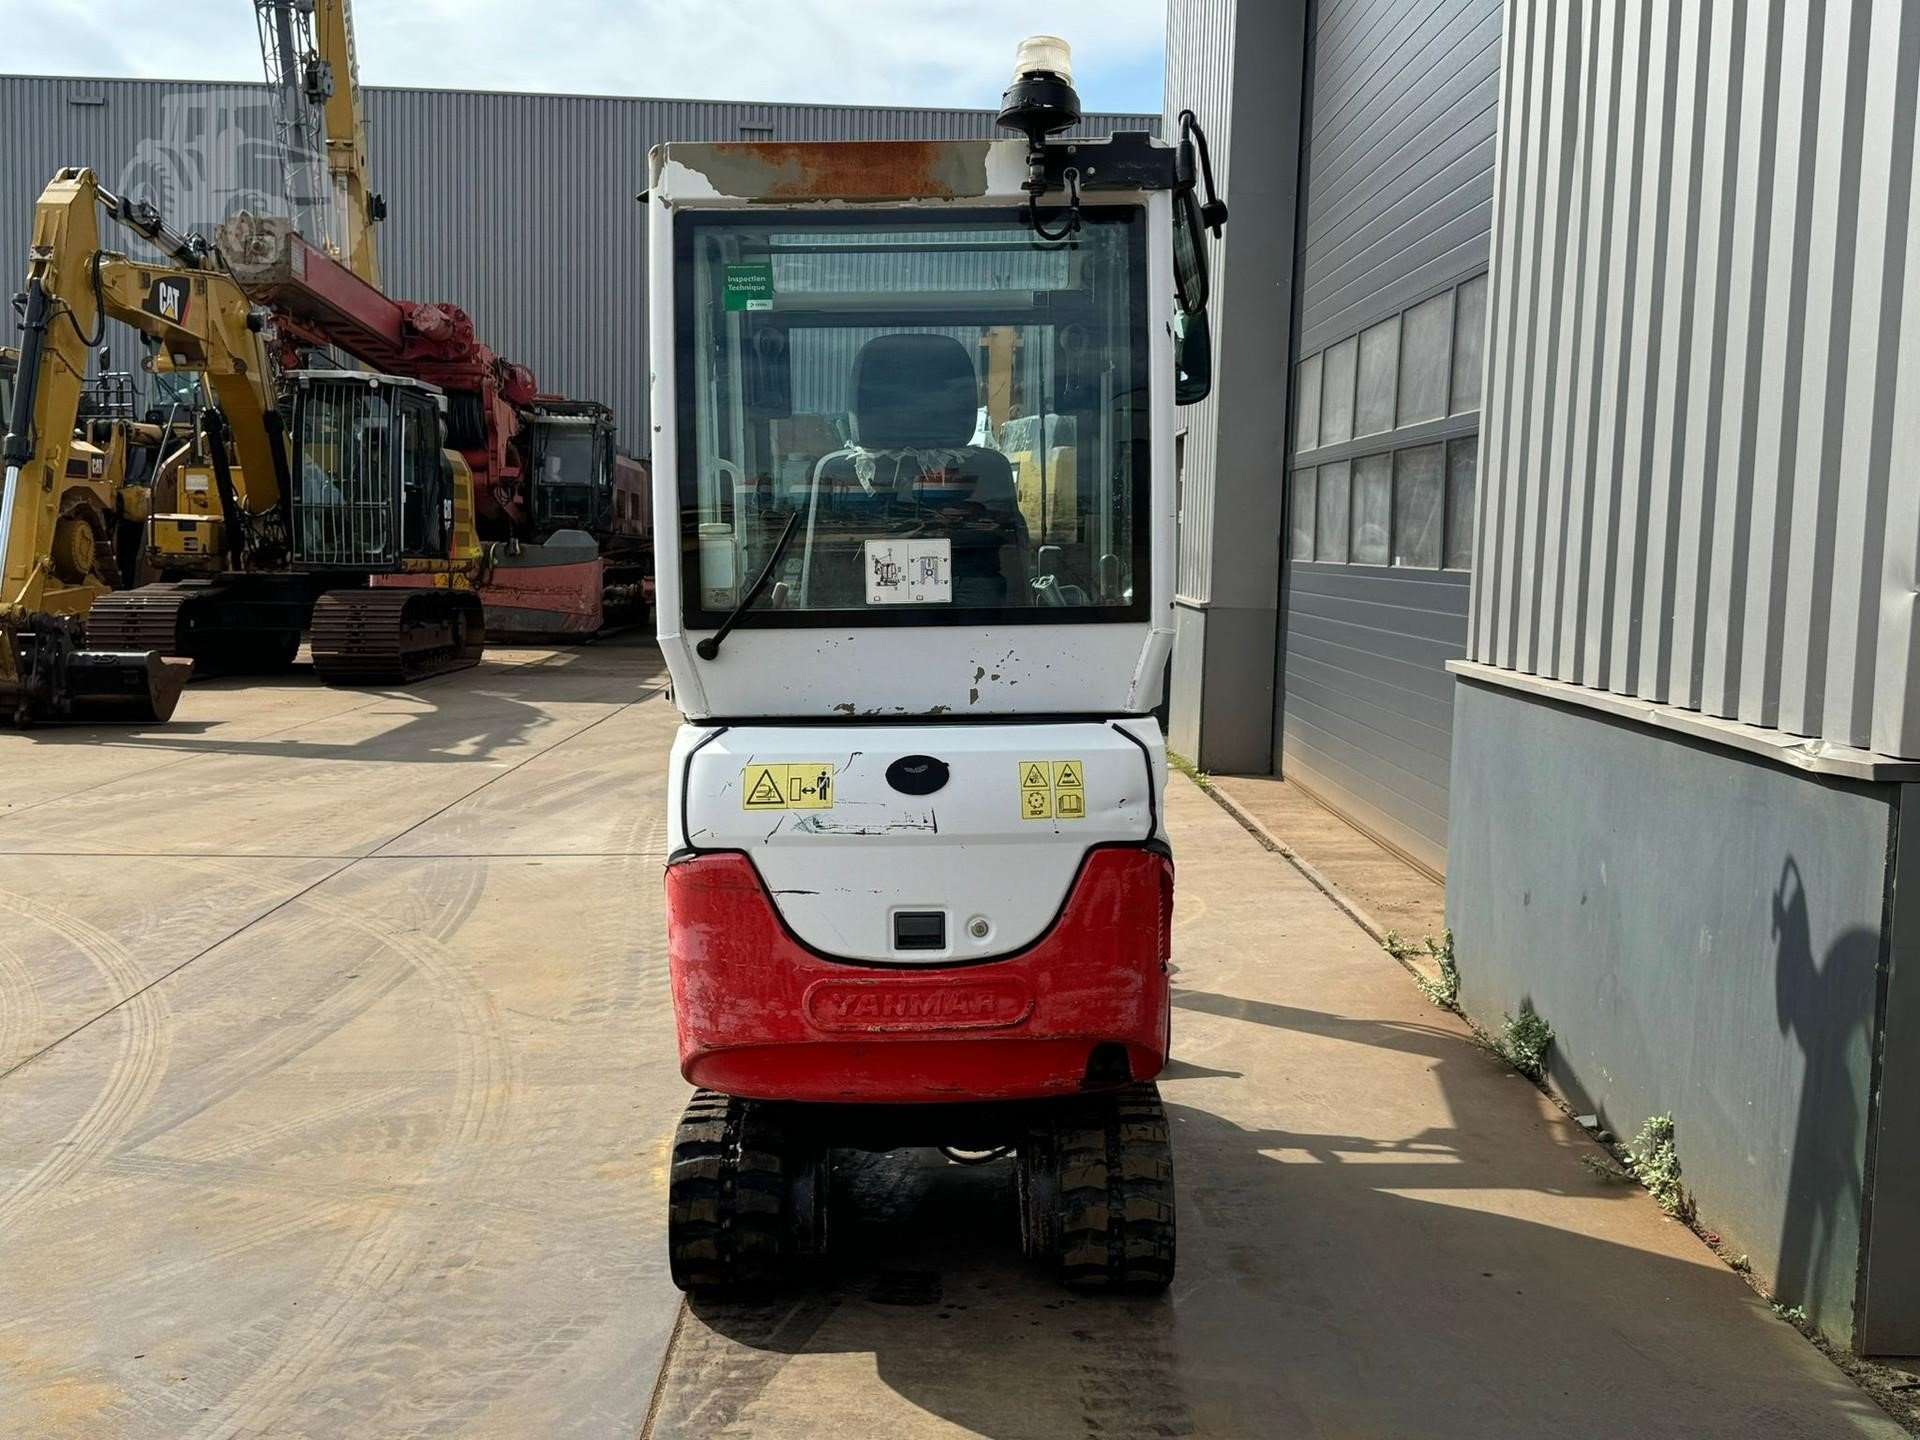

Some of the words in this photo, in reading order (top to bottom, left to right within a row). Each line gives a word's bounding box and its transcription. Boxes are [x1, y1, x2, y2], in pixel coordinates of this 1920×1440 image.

[728, 275, 766, 283] Inspection
[728, 284, 766, 292] Technique
[159, 281, 180, 321] CAT
[832, 991, 995, 1017] YANMAR
